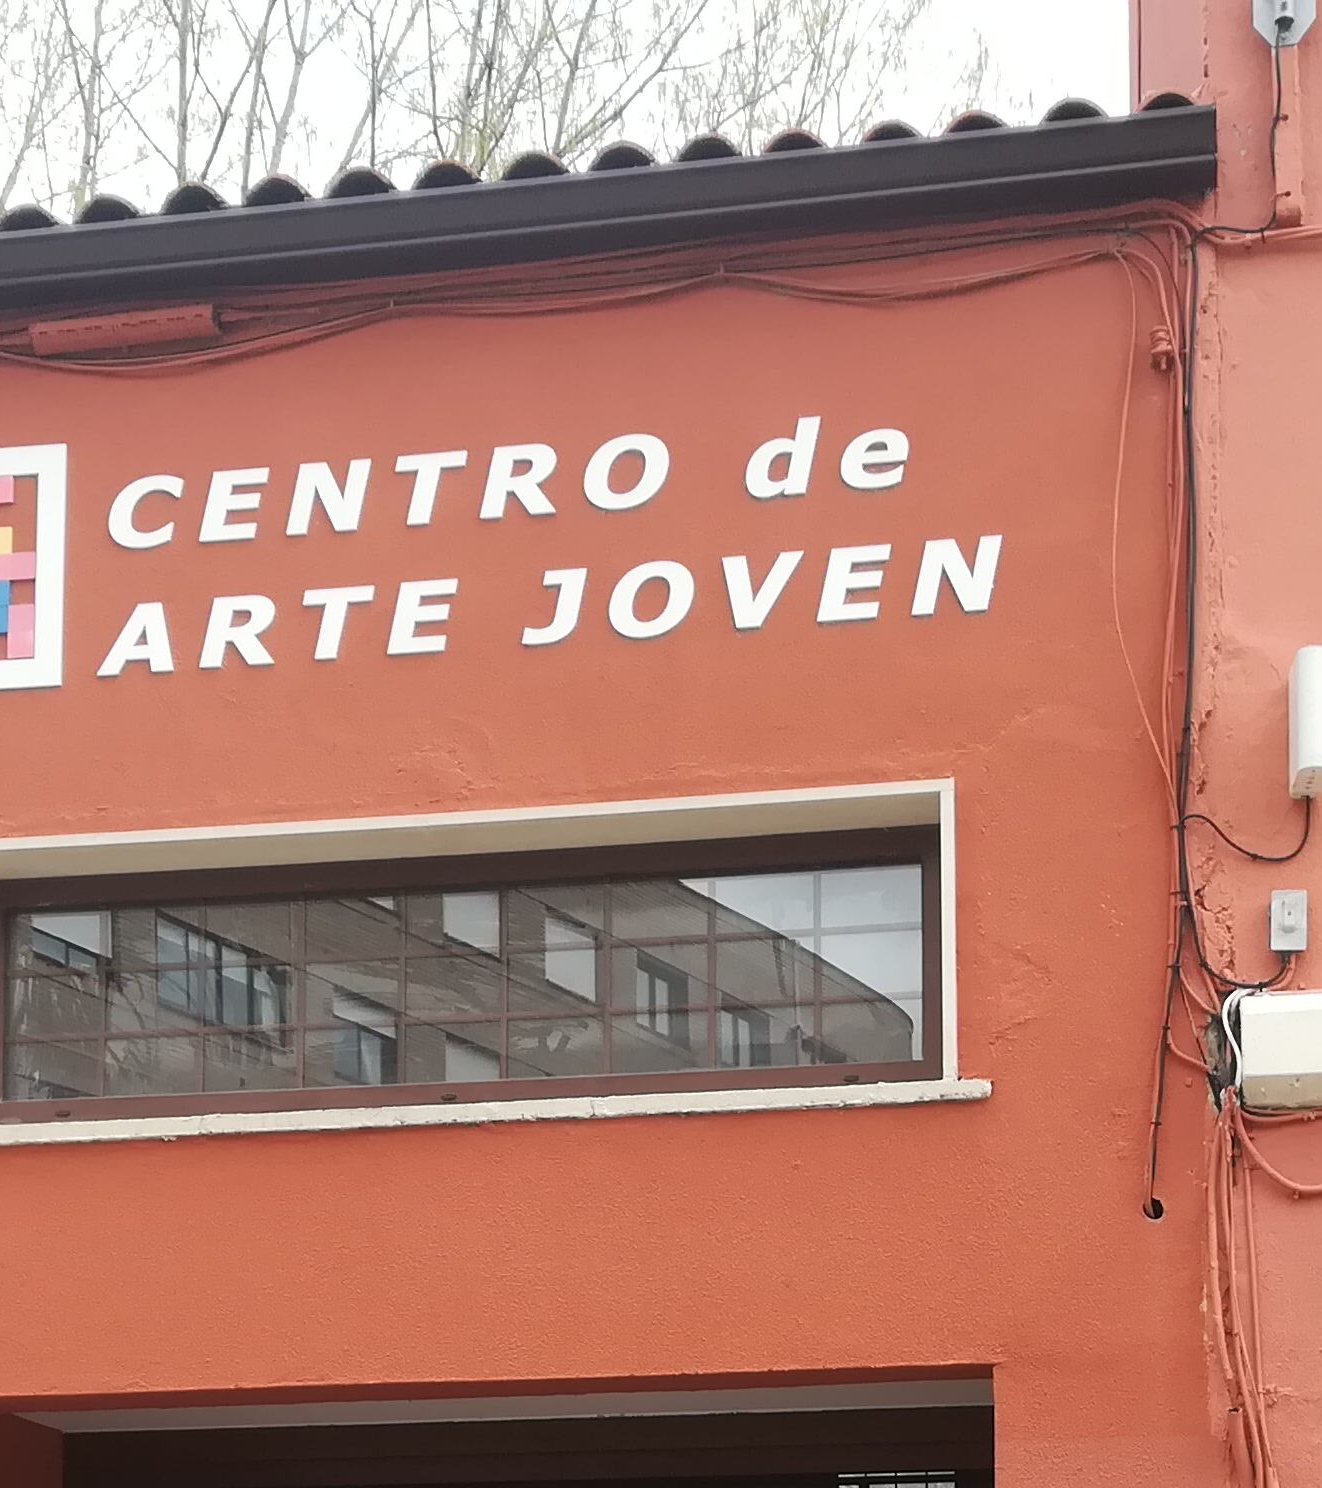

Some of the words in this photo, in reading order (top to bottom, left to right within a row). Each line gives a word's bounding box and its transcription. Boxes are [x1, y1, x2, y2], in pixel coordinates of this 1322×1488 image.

[106, 432, 671, 550] CENTRO
[744, 415, 910, 501] de
[96, 576, 460, 678] ARTE
[521, 533, 1003, 647] JOVEN
